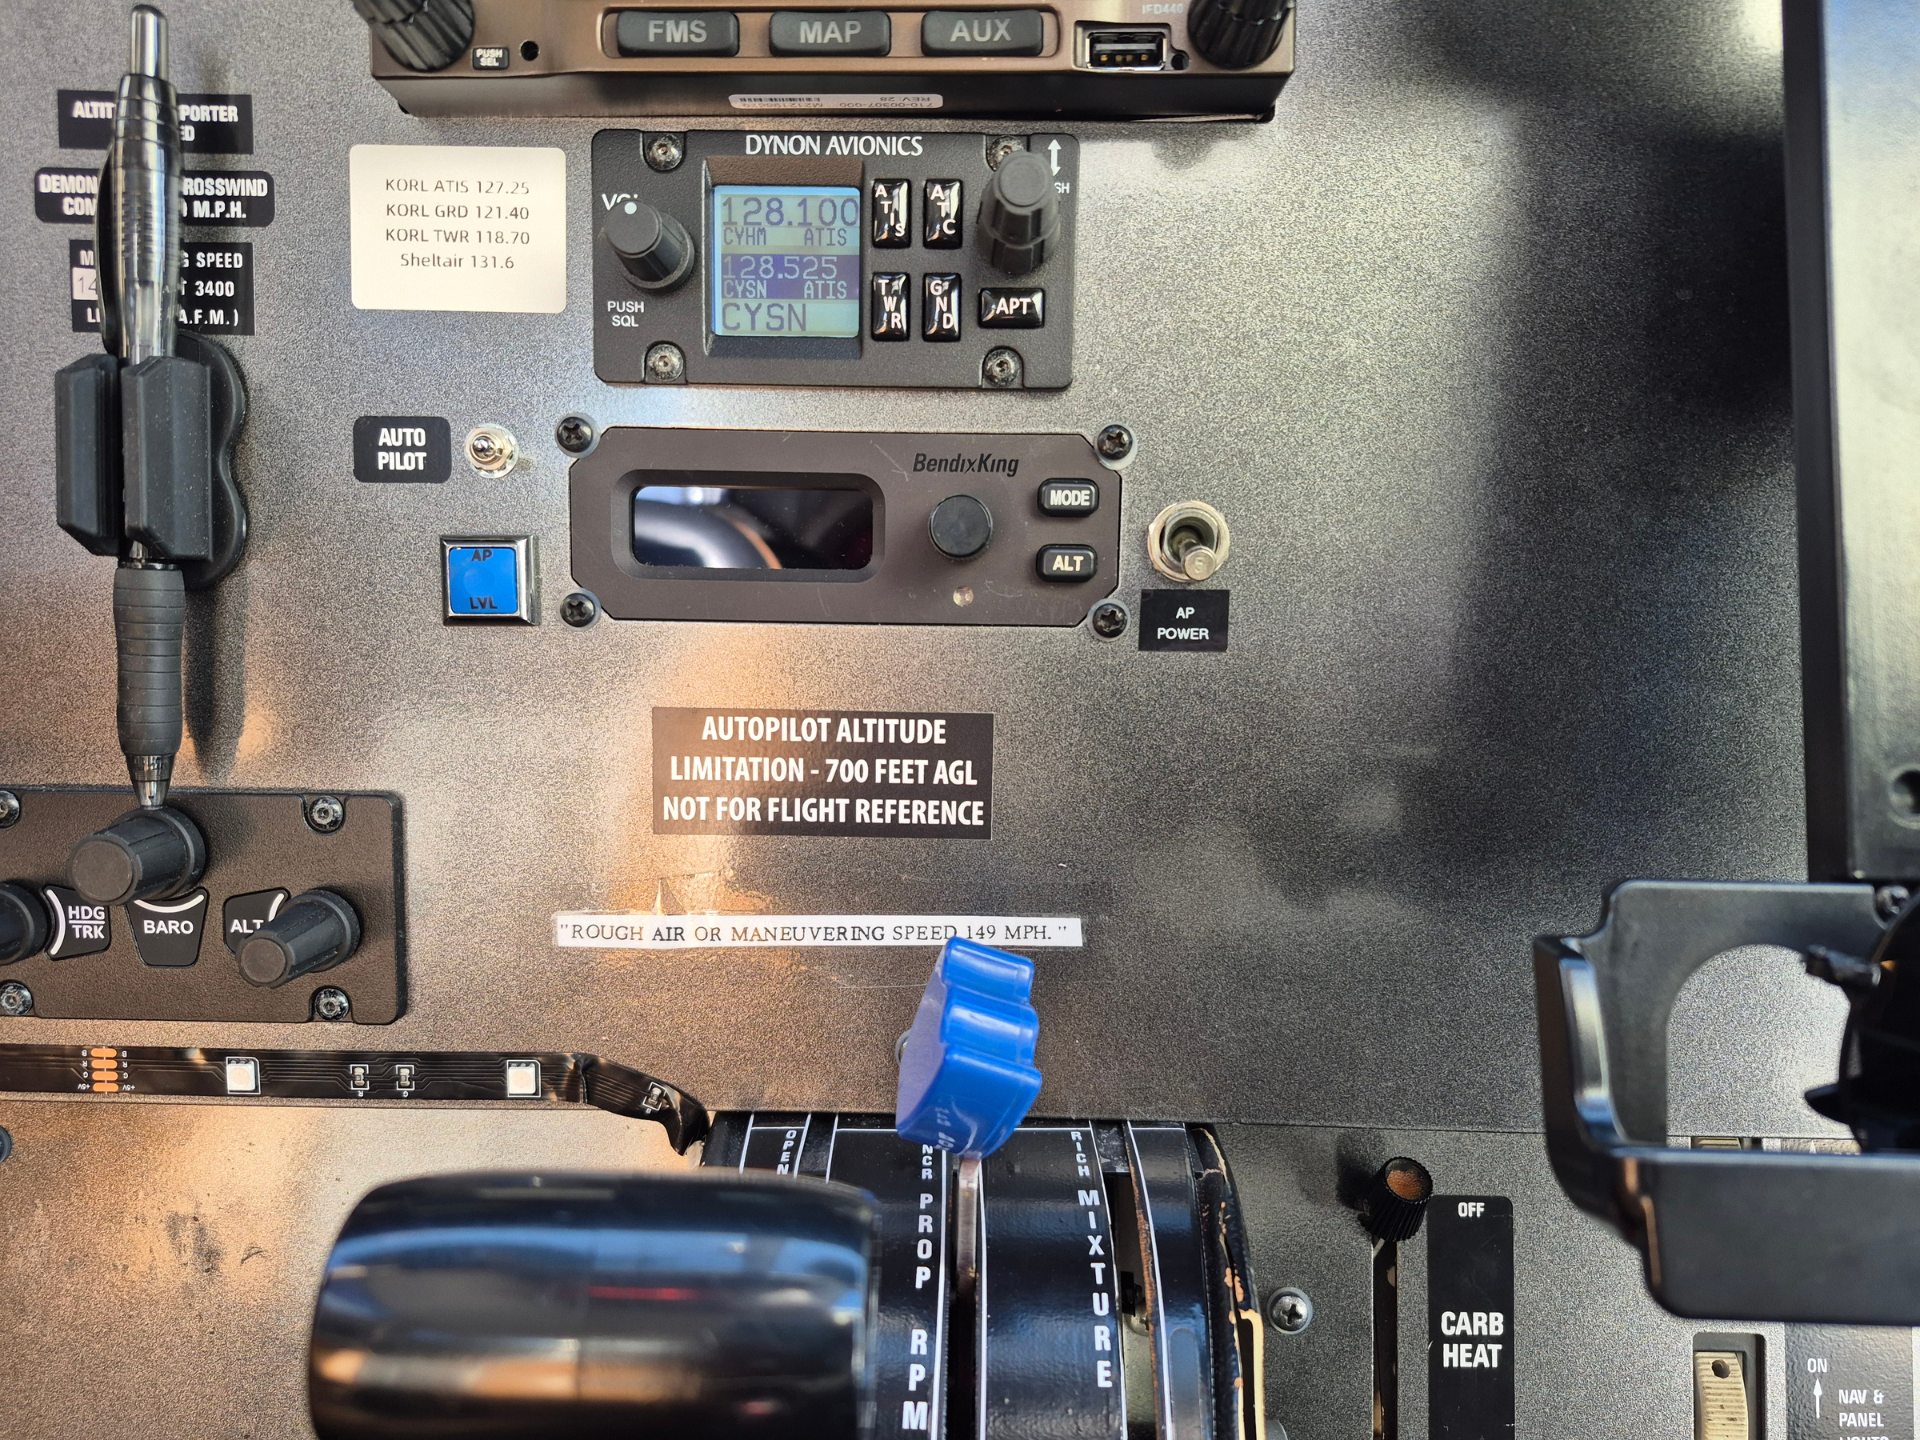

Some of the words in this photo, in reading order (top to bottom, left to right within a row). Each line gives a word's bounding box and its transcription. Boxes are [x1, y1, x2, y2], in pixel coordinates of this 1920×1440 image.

[648, 20, 707, 43] FMS
[800, 20, 861, 44] MAP
[950, 19, 1011, 42] AUX
[476, 48, 502, 58] PUSH
[480, 57, 499, 66] SEL
[72, 101, 116, 119] ALTIT
[180, 105, 238, 122] PORTER
[745, 135, 821, 156] DYNON
[825, 135, 923, 157] AVIONICS
[39, 174, 98, 194] DEMON
[183, 177, 268, 197] ROSSWIND
[385, 178, 429, 192] KORL
[434, 180, 469, 193] ATIS
[477, 181, 530, 195] 127.25
[193, 201, 247, 218] M.P.H.
[386, 203, 430, 217] KORL
[434, 204, 469, 218] GRD
[476, 205, 529, 220] 121.40
[722, 197, 859, 226] 128.100
[875, 185, 905, 237] ATIS
[930, 185, 956, 235] ATC
[385, 228, 429, 242] KORL
[433, 230, 470, 243] TWR
[476, 231, 530, 245] 118.70
[723, 227, 767, 246] CYHM
[804, 227, 847, 246] ATIS
[196, 252, 243, 268] SPEED
[400, 253, 464, 268] Sheltair
[471, 255, 515, 269] 131.6
[722, 255, 838, 279] 128.525
[194, 280, 235, 297] 3400
[723, 280, 767, 299] CYSN
[803, 280, 847, 299] ATIS
[607, 301, 645, 313] PUSH
[878, 279, 902, 329] TWR
[930, 280, 954, 329] GND
[996, 298, 1032, 315] APT
[611, 315, 639, 327] SQL
[721, 302, 806, 331] CYSN
[378, 428, 426, 447] AUTO
[377, 452, 427, 471] PILOT
[913, 453, 1019, 477] BendixKing
[1050, 489, 1090, 507] MODE
[471, 549, 493, 562] AP
[1052, 556, 1084, 572] ALT
[469, 597, 498, 610] LVL
[1176, 607, 1195, 619] AP
[1157, 628, 1209, 640] POWER
[701, 716, 831, 742] AUTOPILOT
[836, 719, 947, 744] ALTITUDE
[670, 756, 804, 782] LIMITATION
[825, 759, 869, 783] 700
[875, 759, 929, 784] FEET
[933, 760, 978, 785] AGL
[663, 796, 710, 821] NOT
[716, 796, 762, 822] FOR
[767, 798, 850, 823] FLIGHT
[855, 799, 984, 826] REFERENCE
[68, 905, 105, 920] HDG
[72, 925, 105, 940] TRK
[143, 919, 194, 935] BARO
[230, 919, 264, 933] ALT
[652, 927, 685, 942] AIR
[694, 926, 722, 942] OR
[731, 926, 885, 942] MANEUVERING
[892, 925, 957, 940] SPEED
[967, 924, 996, 939] 149
[776, 1130, 797, 1175] OPEN
[922, 1144, 934, 1179] NCR
[1070, 1130, 1091, 1177] RICH
[1458, 1202, 1485, 1217] OFF
[915, 1193, 934, 1290] PROP
[1077, 1189, 1113, 1388] MIXTURE
[1441, 1311, 1504, 1336] CARB
[1443, 1343, 1502, 1368] HEAT
[1807, 1358, 1828, 1373] ON
[902, 1328, 929, 1431] RPM
[1838, 1389, 1867, 1404] NAV
[1873, 1389, 1884, 1404] &
[1839, 1412, 1885, 1428] PANEL
